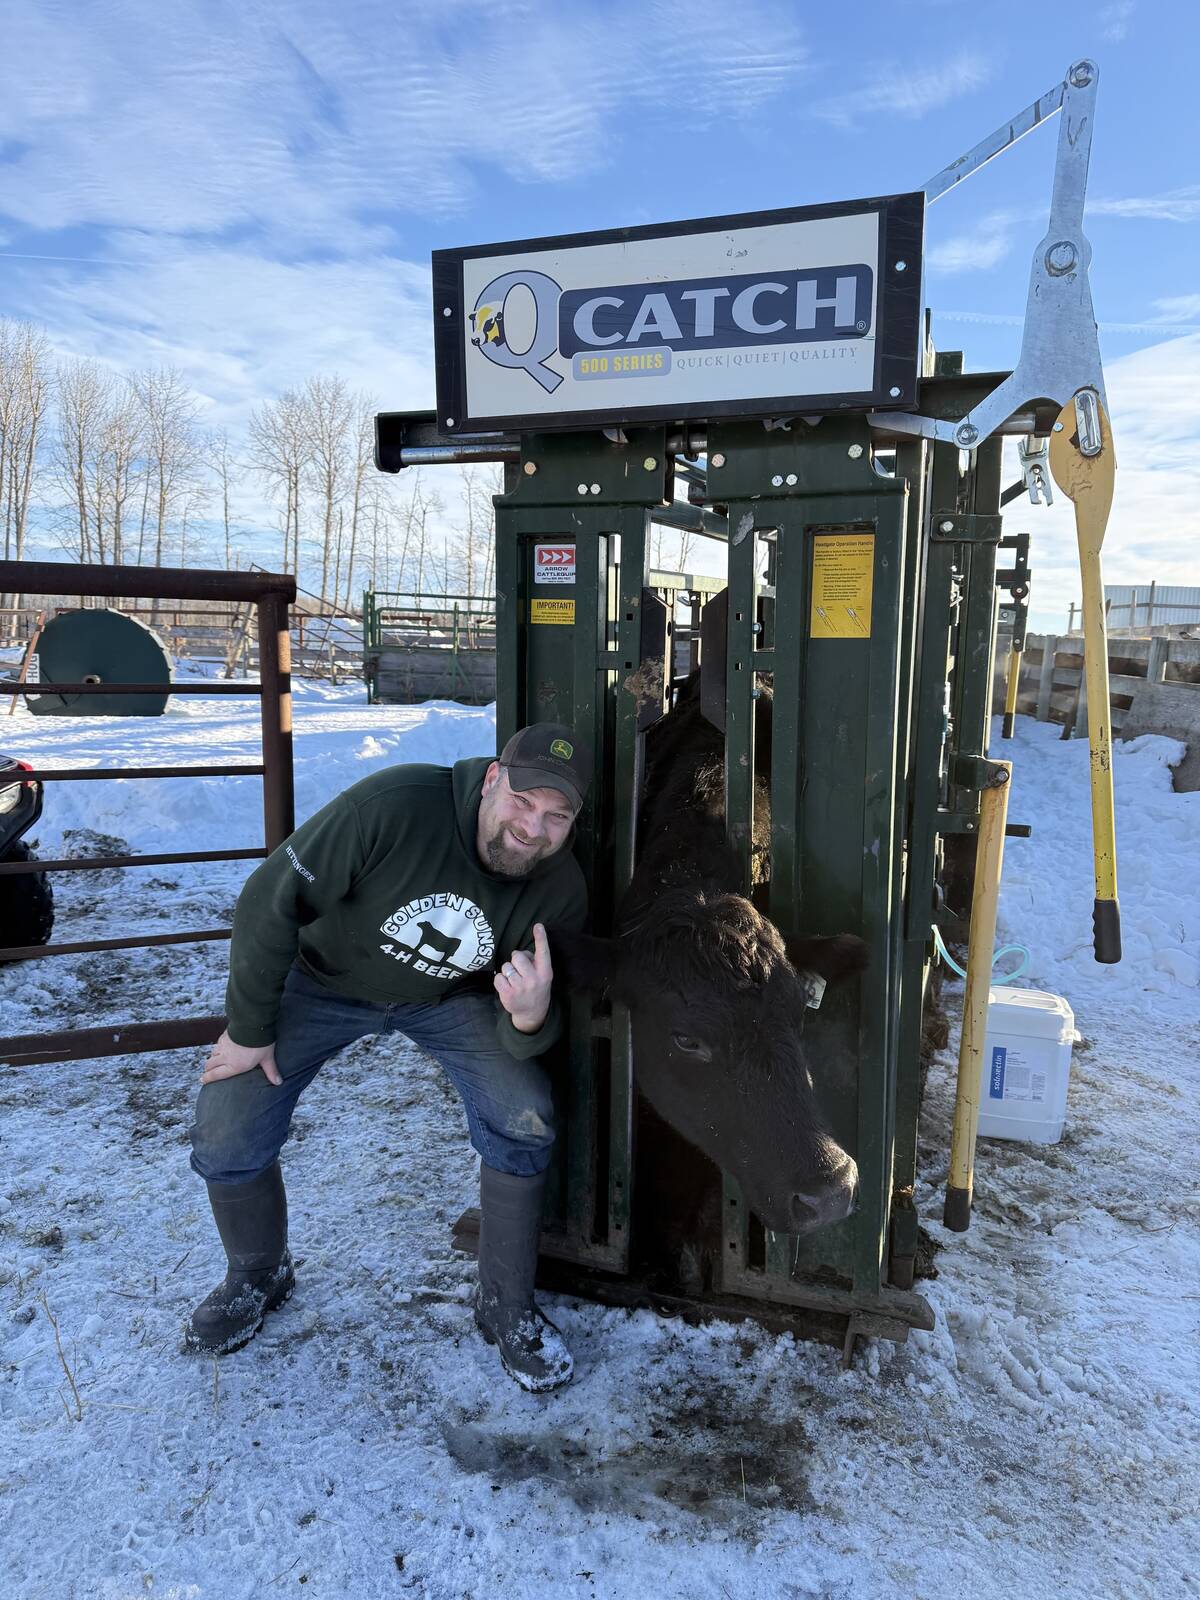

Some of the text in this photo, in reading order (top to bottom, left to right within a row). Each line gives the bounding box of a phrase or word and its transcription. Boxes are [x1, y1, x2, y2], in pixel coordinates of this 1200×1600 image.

[470, 270, 565, 394] Q
[572, 276, 858, 346] CATCH
[580, 353, 664, 374] 500 SERIES
[381, 893, 463, 936] GOLDEN
[380, 944, 462, 979] 4-H BEEF
